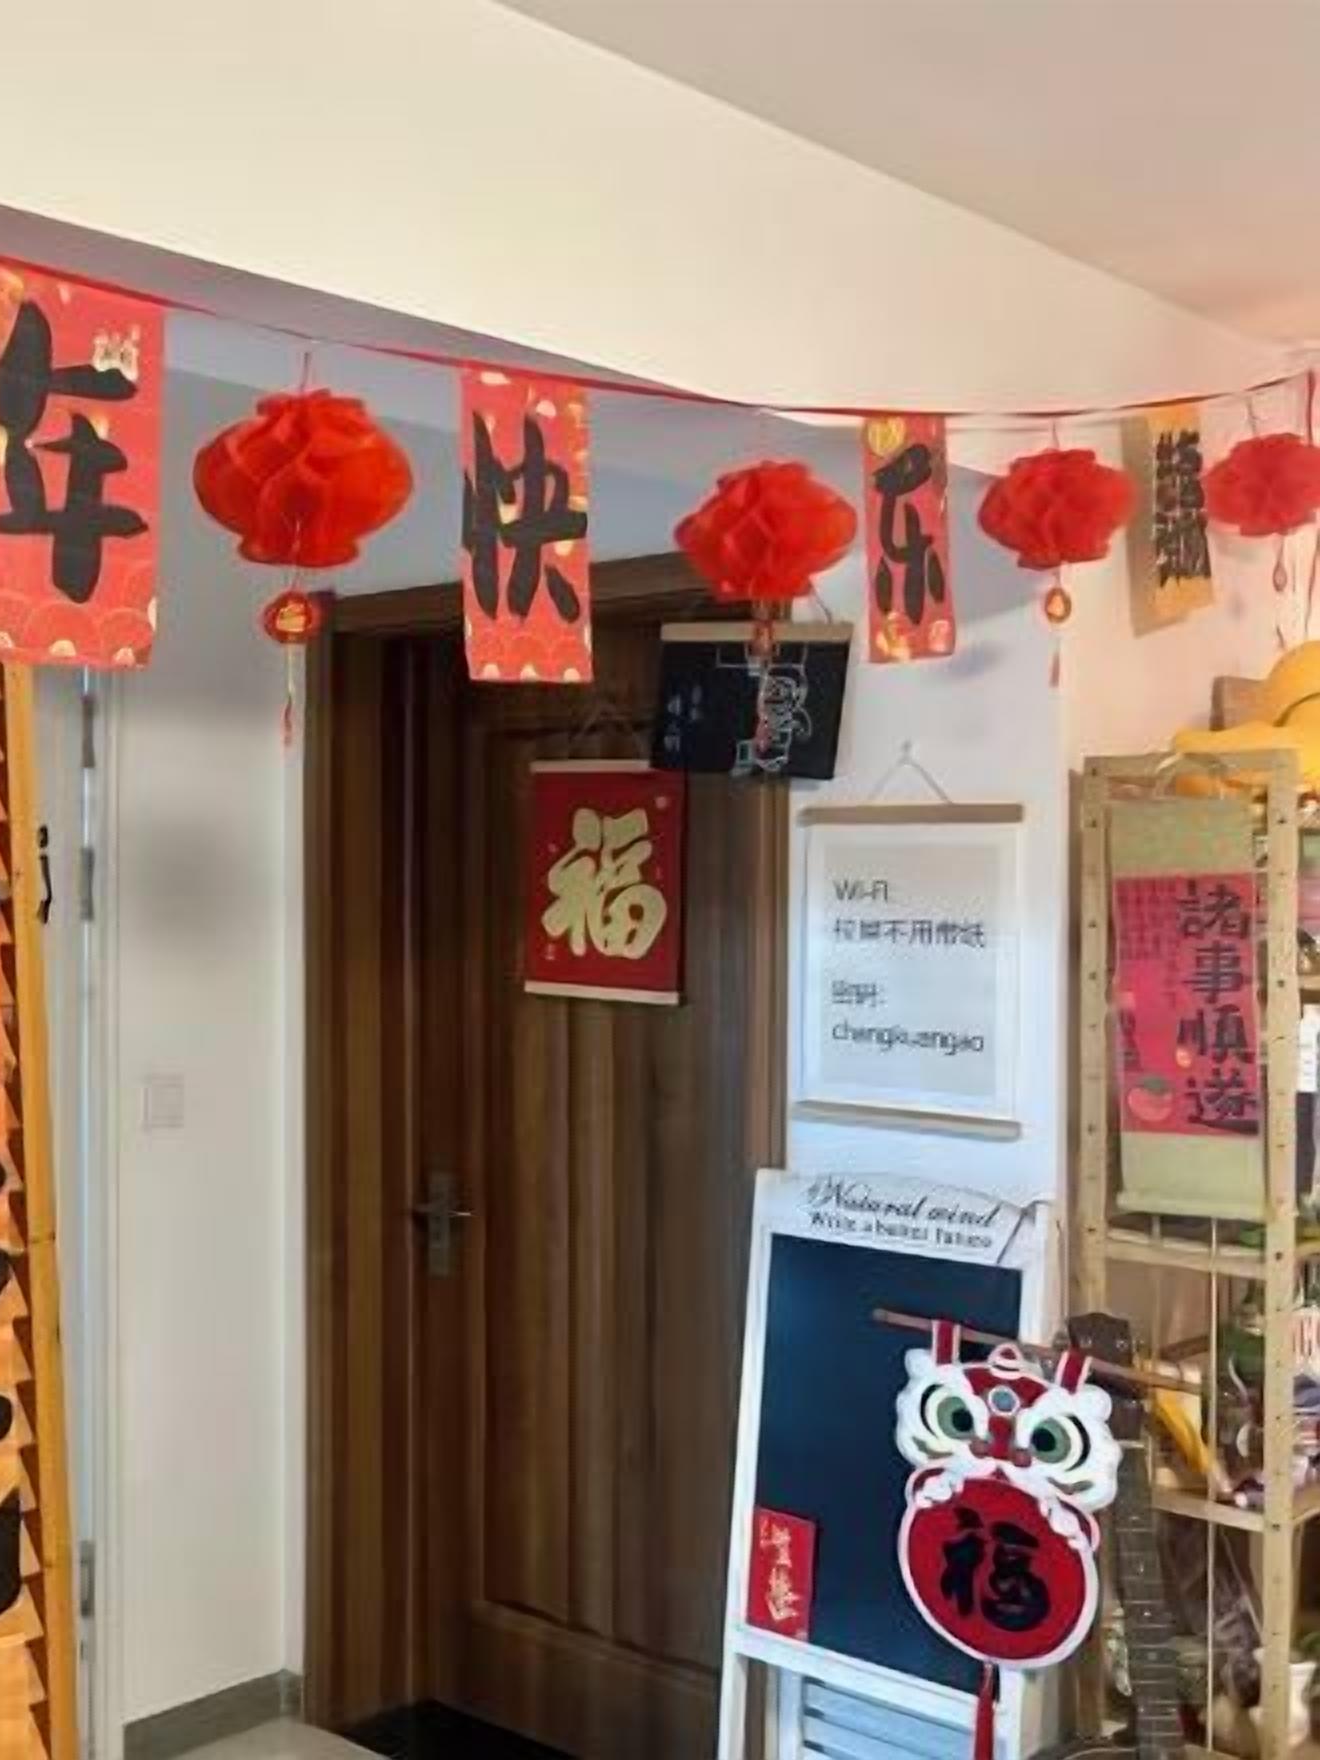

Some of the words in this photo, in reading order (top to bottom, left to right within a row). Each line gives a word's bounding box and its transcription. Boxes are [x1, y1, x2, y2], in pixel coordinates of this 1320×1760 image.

[462, 410, 588, 624] 快
[873, 443, 948, 626] 乐
[541, 808, 668, 960] 福
[940, 1507, 1050, 1632] 福
